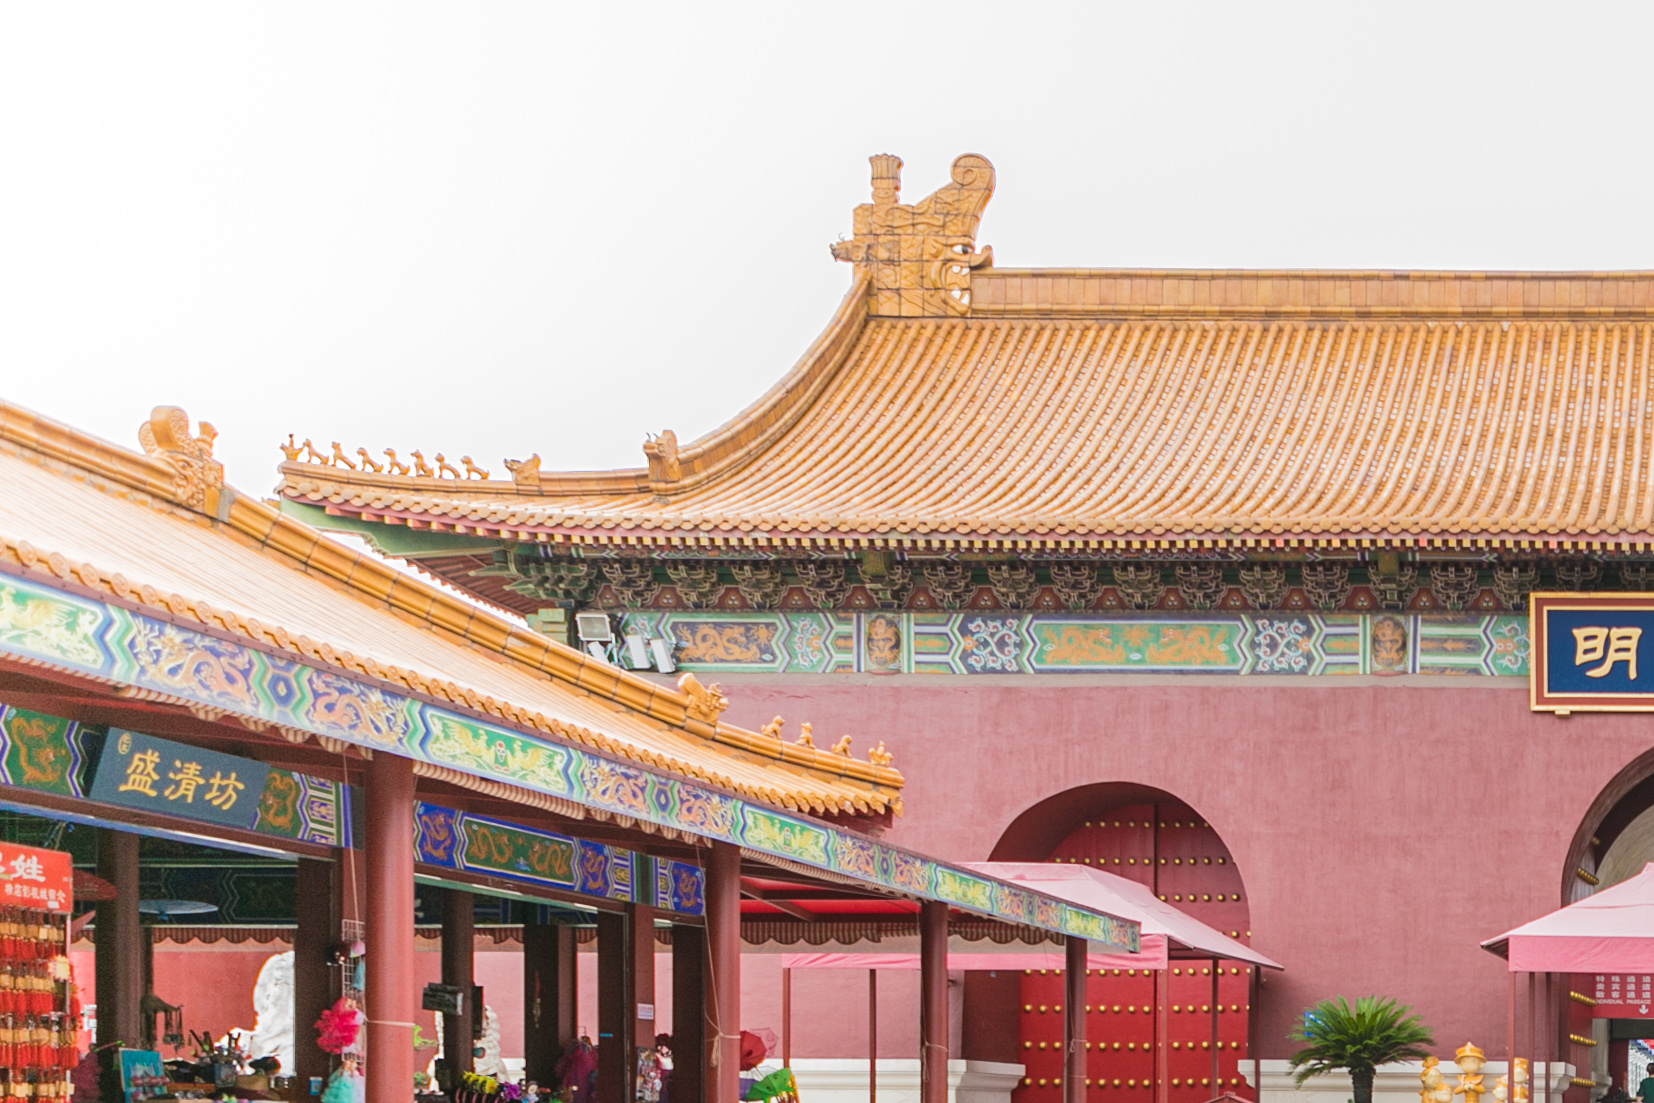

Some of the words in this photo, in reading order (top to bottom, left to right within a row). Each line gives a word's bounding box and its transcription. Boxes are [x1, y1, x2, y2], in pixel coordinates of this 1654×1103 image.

[118, 749, 246, 811] 盛清坊
[0, 852, 46, 882] 姓
